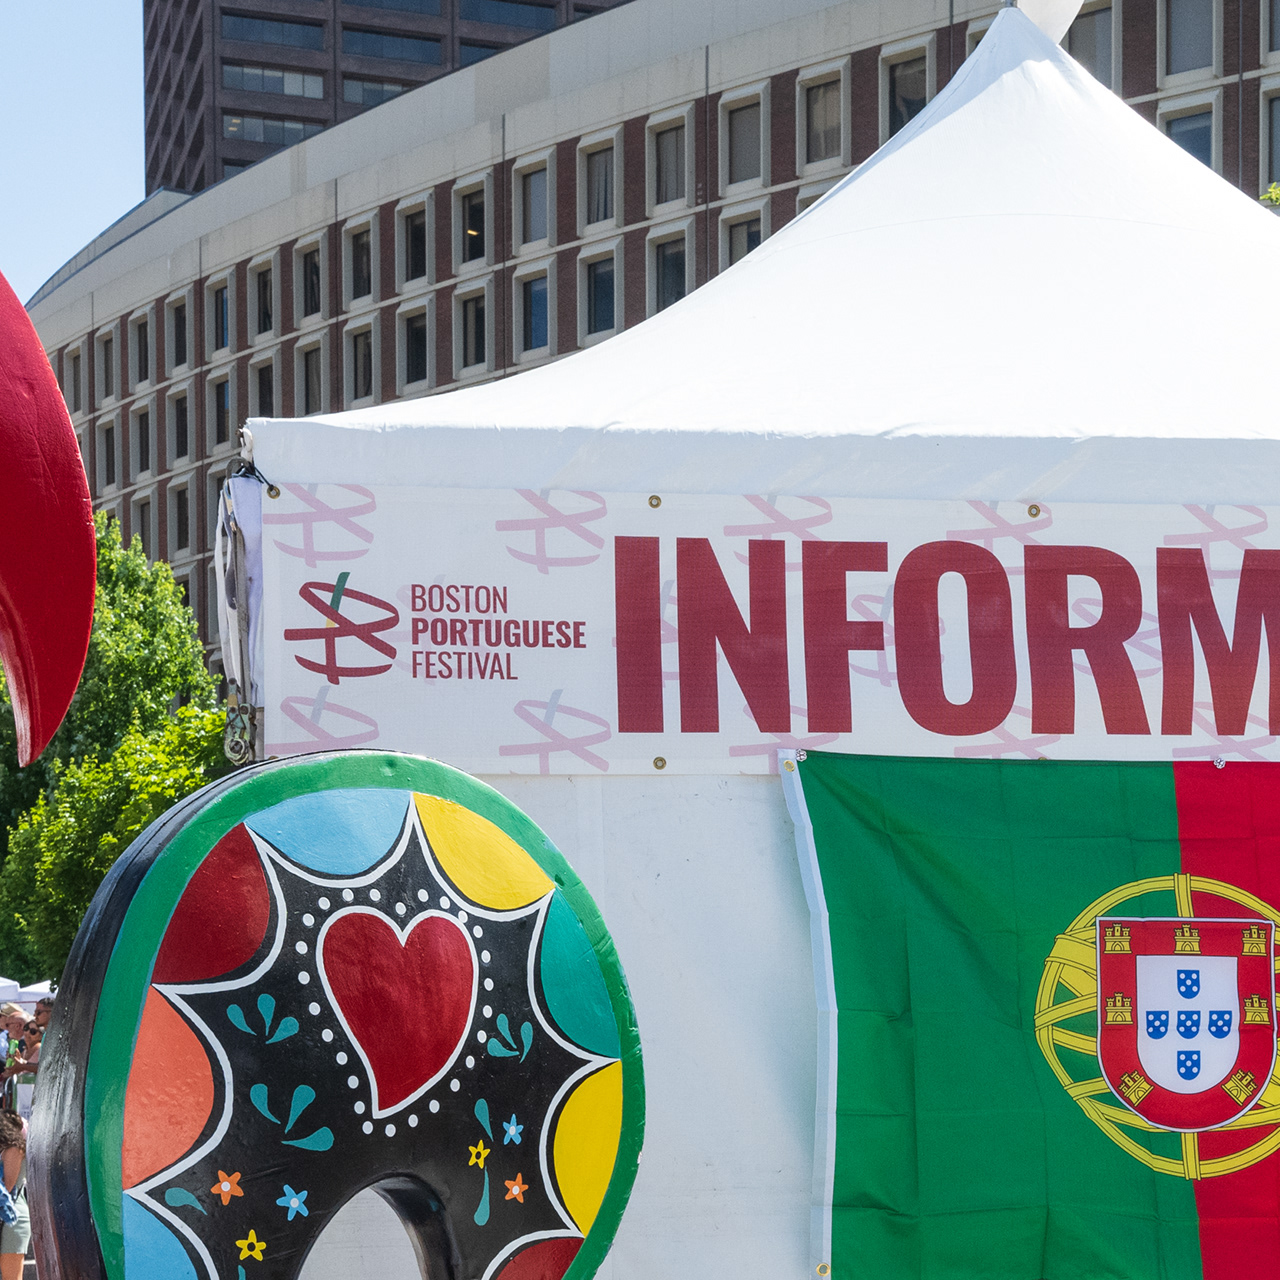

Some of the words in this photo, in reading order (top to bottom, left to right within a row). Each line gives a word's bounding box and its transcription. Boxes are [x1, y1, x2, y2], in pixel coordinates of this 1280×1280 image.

[411, 584, 508, 614] BOSTON
[411, 617, 587, 649] PORTUGUESE
[412, 650, 519, 680] FESTIVAL
